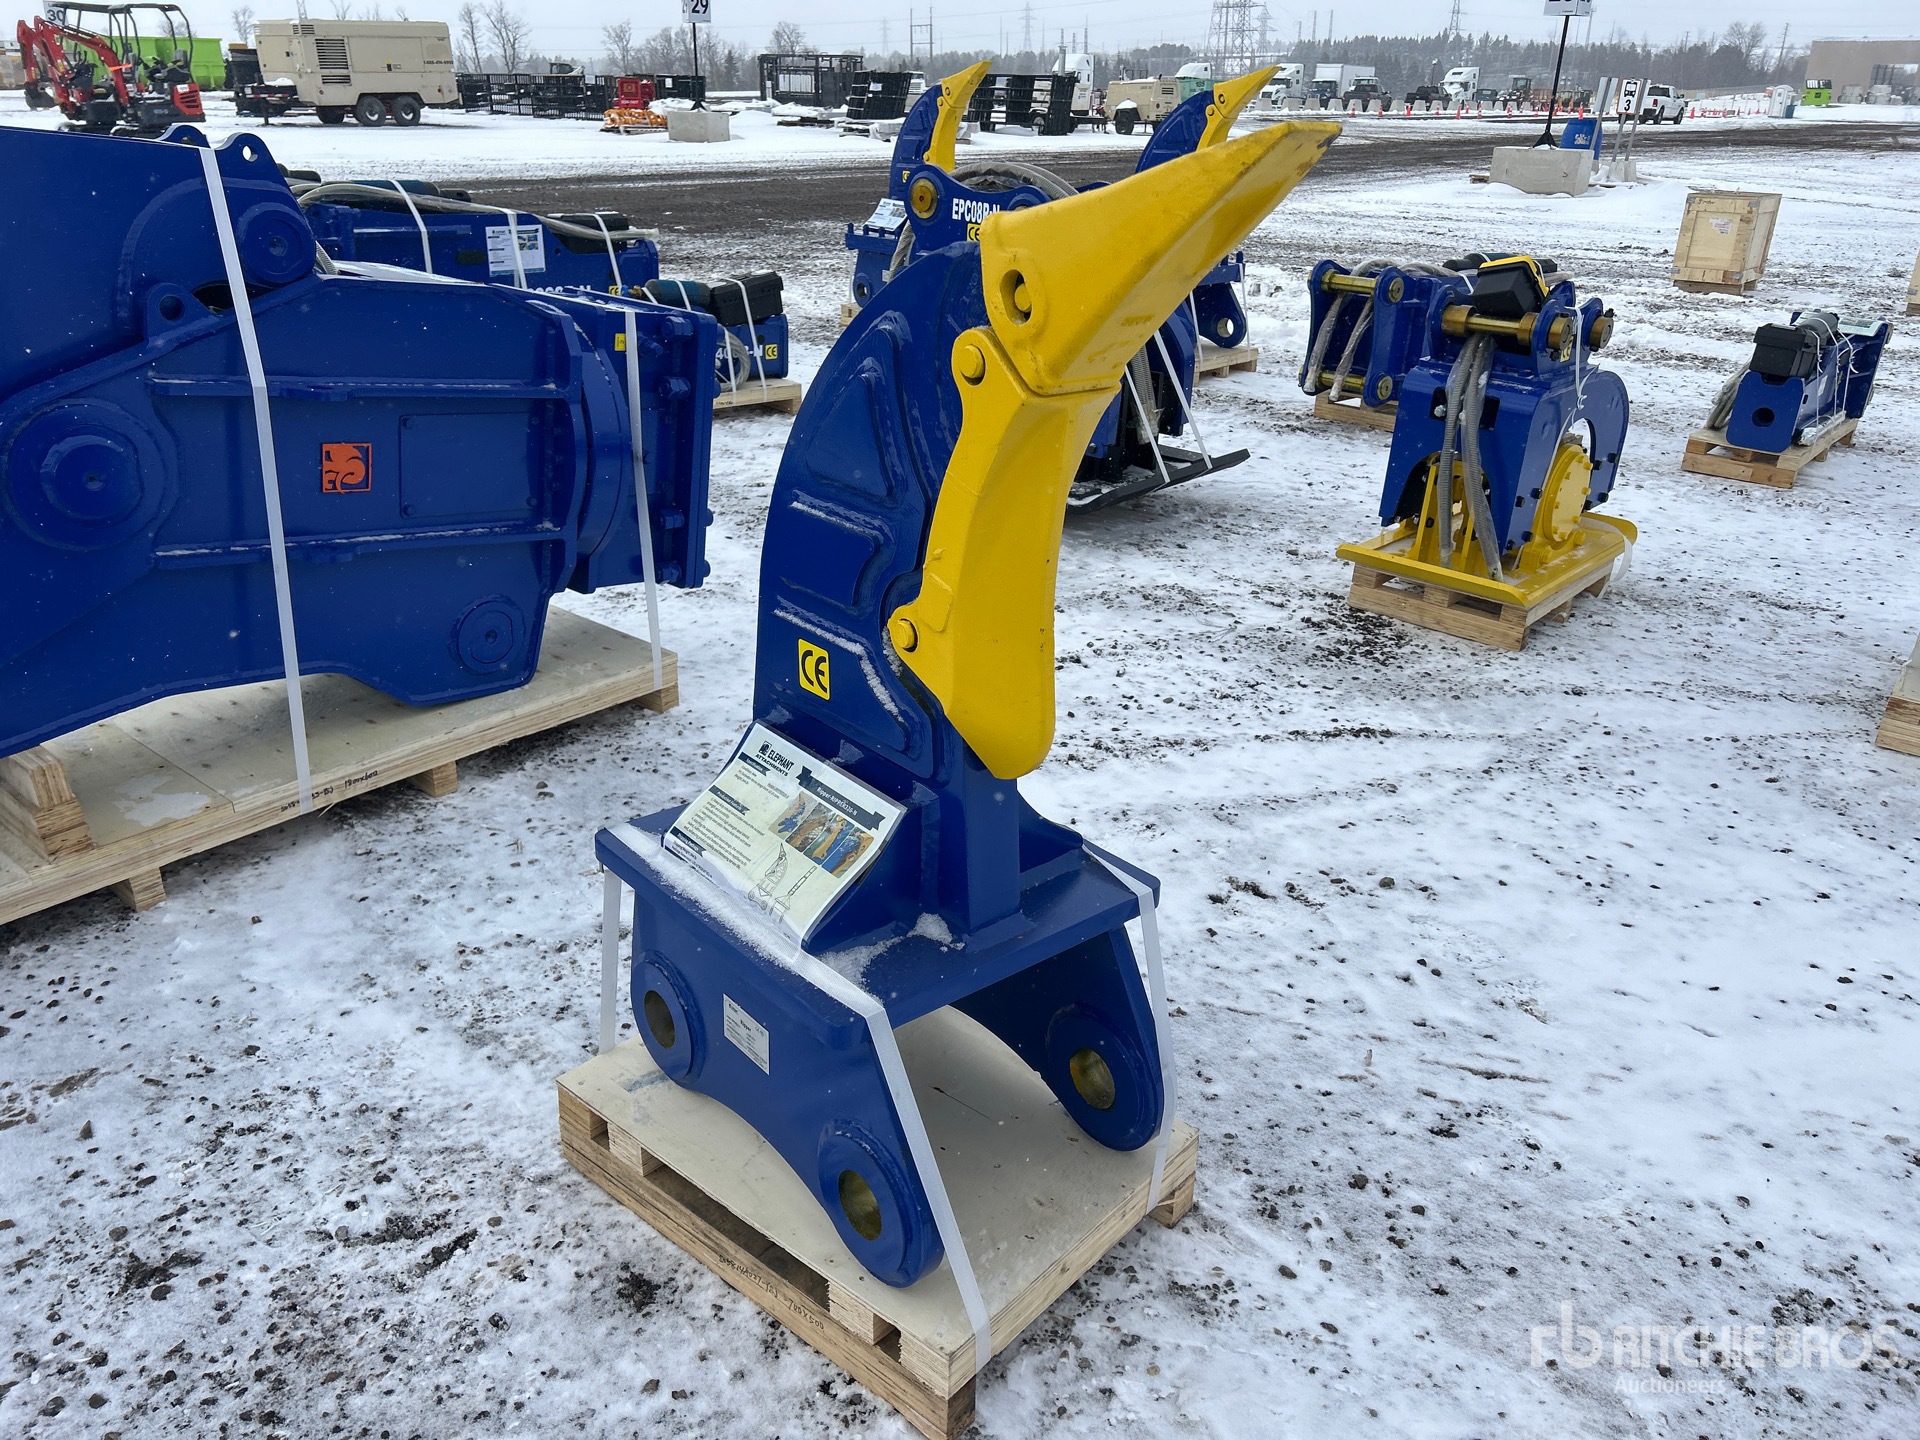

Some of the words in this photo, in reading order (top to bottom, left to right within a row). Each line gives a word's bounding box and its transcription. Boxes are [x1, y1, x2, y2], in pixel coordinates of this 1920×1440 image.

[691, 0, 708, 14] 29
[1624, 99, 1631, 111] 3
[766, 346, 777, 357] CE
[801, 650, 827, 693] CE
[755, 753, 788, 777] ATTACHMENTS
[766, 749, 794, 771] ELEPHANT
